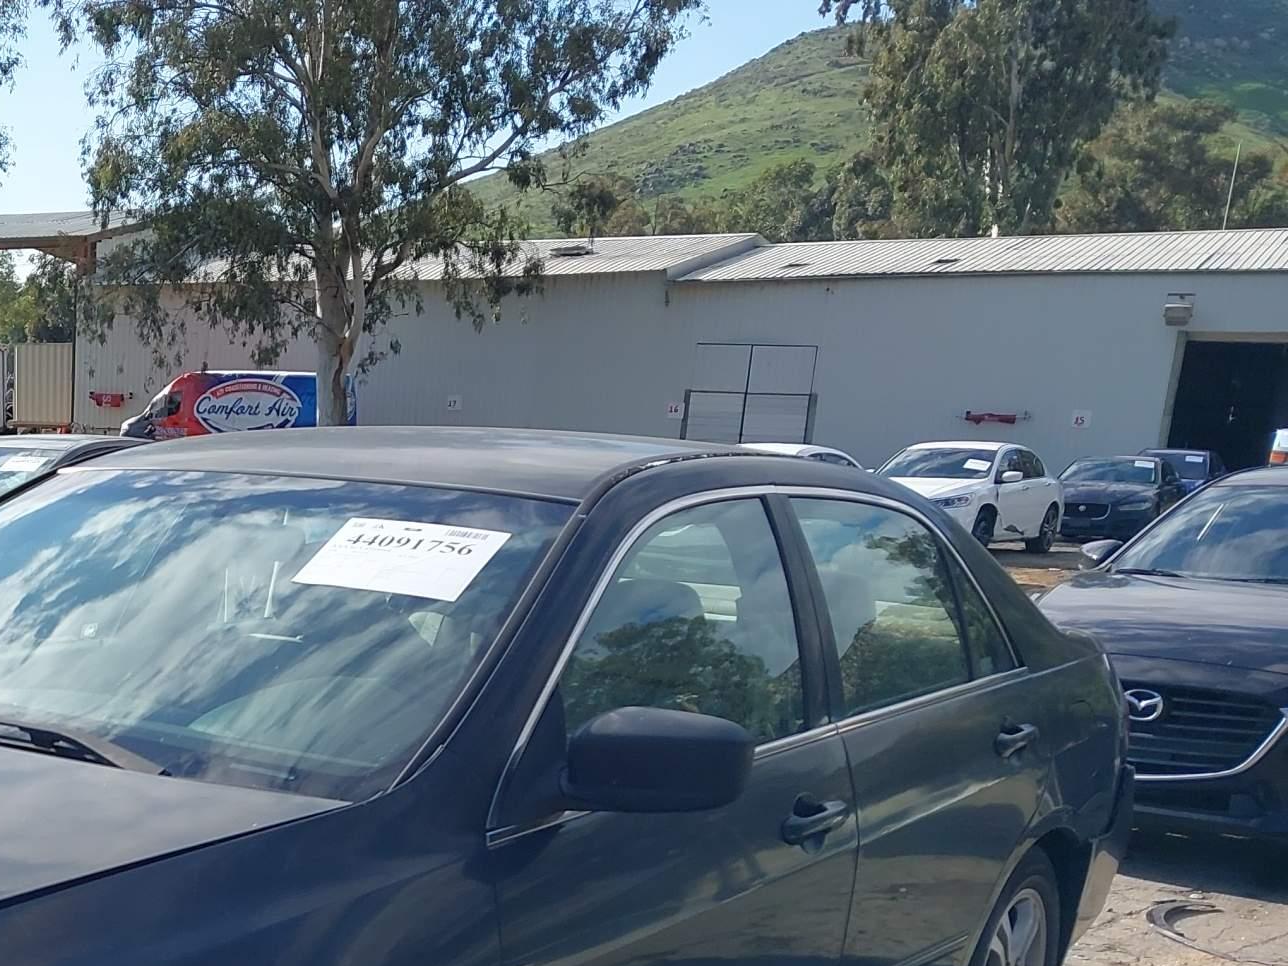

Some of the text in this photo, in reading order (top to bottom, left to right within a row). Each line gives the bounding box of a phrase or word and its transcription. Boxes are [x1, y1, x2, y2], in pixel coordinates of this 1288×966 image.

[196, 396, 297, 419] Comfort Air
[669, 404, 679, 413] 16
[346, 533, 477, 556] 44091756
